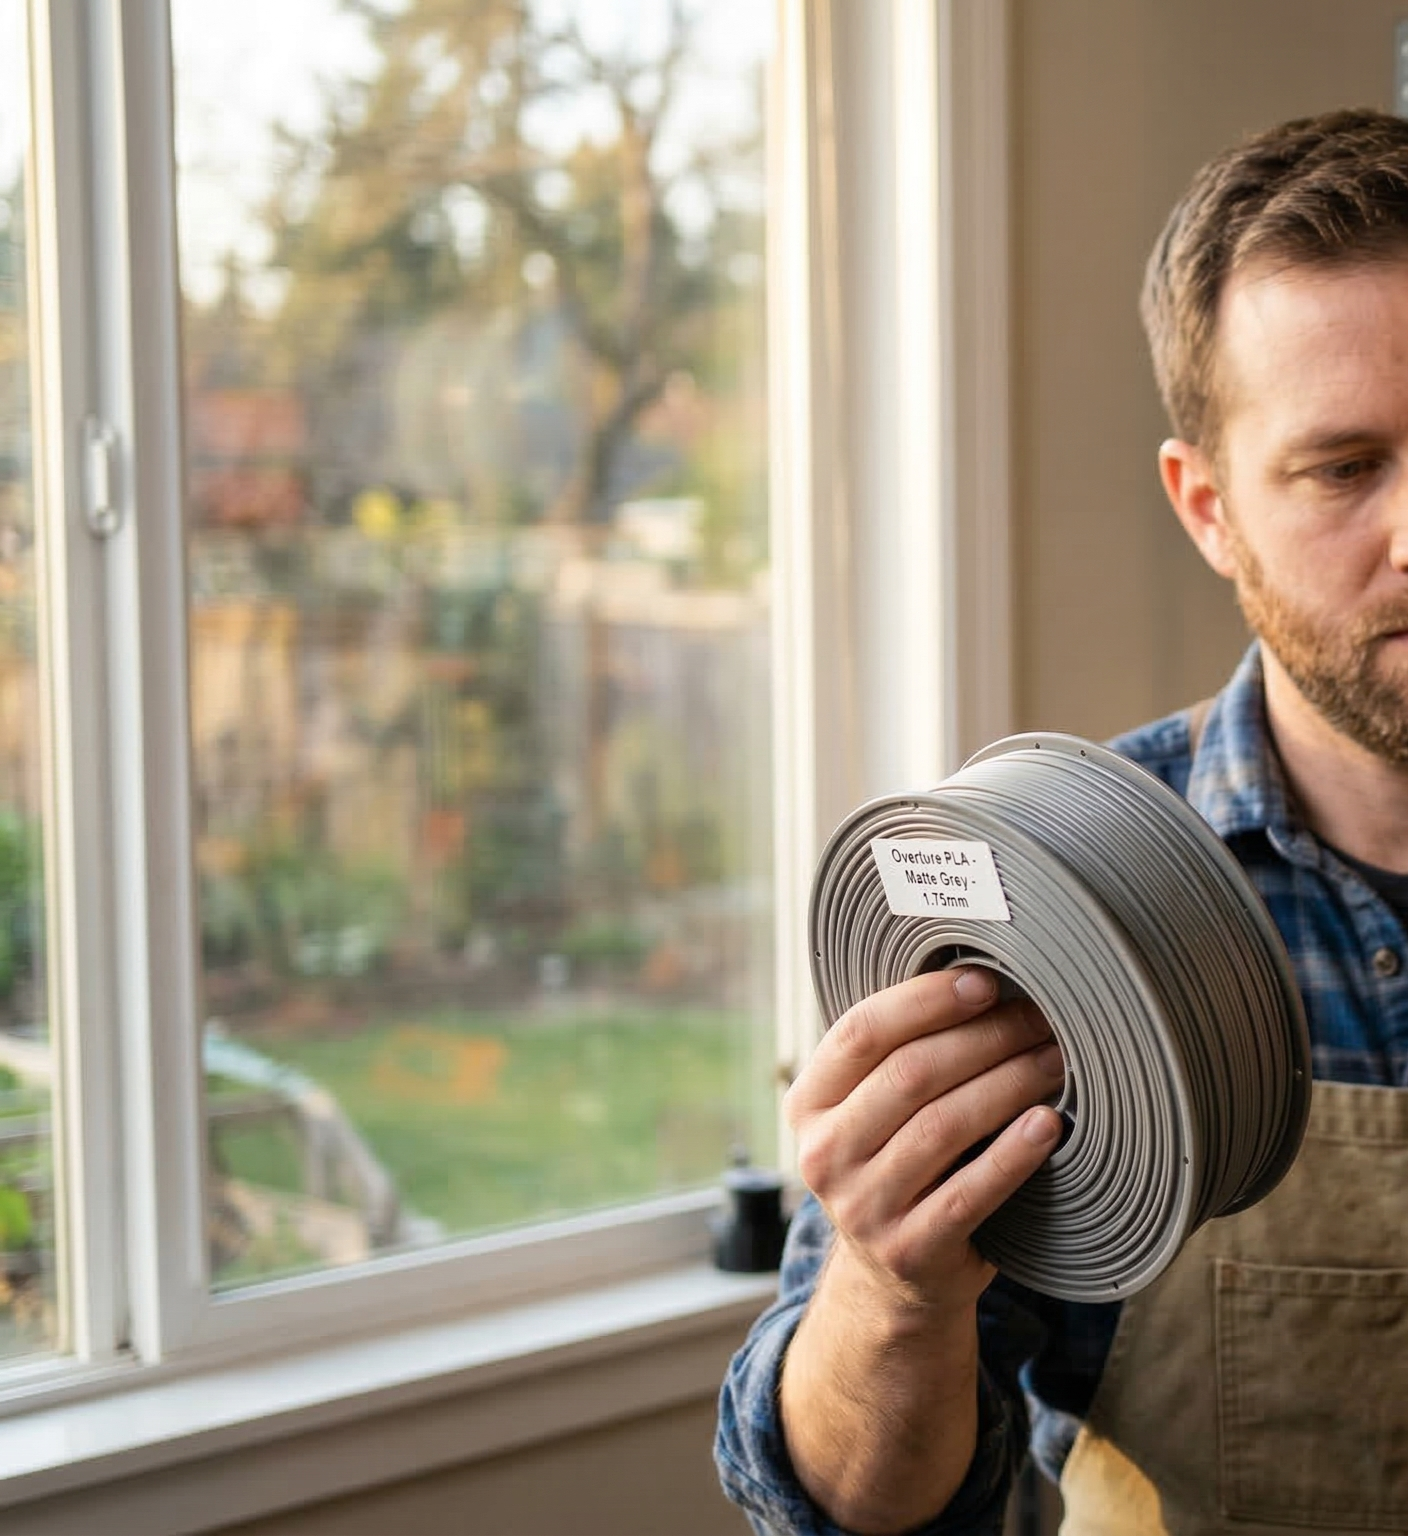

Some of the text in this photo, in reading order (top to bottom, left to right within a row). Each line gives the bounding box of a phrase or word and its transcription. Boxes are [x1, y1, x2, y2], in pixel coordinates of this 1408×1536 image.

[891, 848, 942, 865] Overture
[944, 851, 970, 867] PLA
[905, 869, 938, 886] Matte
[940, 871, 968, 891] Grey
[923, 892, 969, 908] 1.75mm
